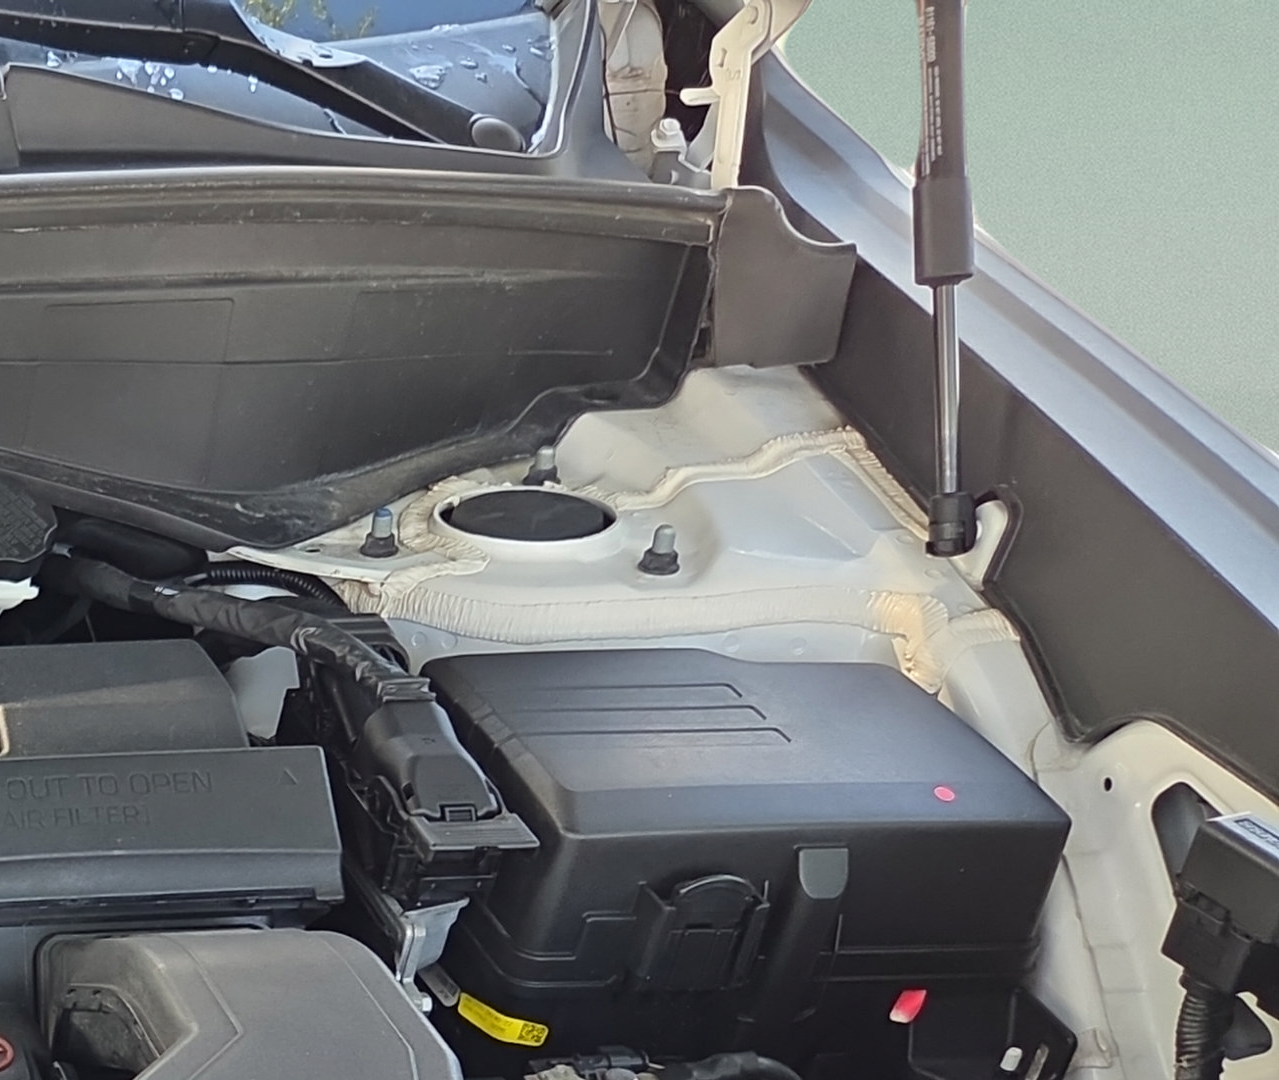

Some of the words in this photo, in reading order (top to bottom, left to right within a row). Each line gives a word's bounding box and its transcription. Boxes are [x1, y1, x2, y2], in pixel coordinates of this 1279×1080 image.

[6, 774, 70, 801] OUT
[75, 773, 119, 797] TO
[128, 770, 213, 796] OPEN
